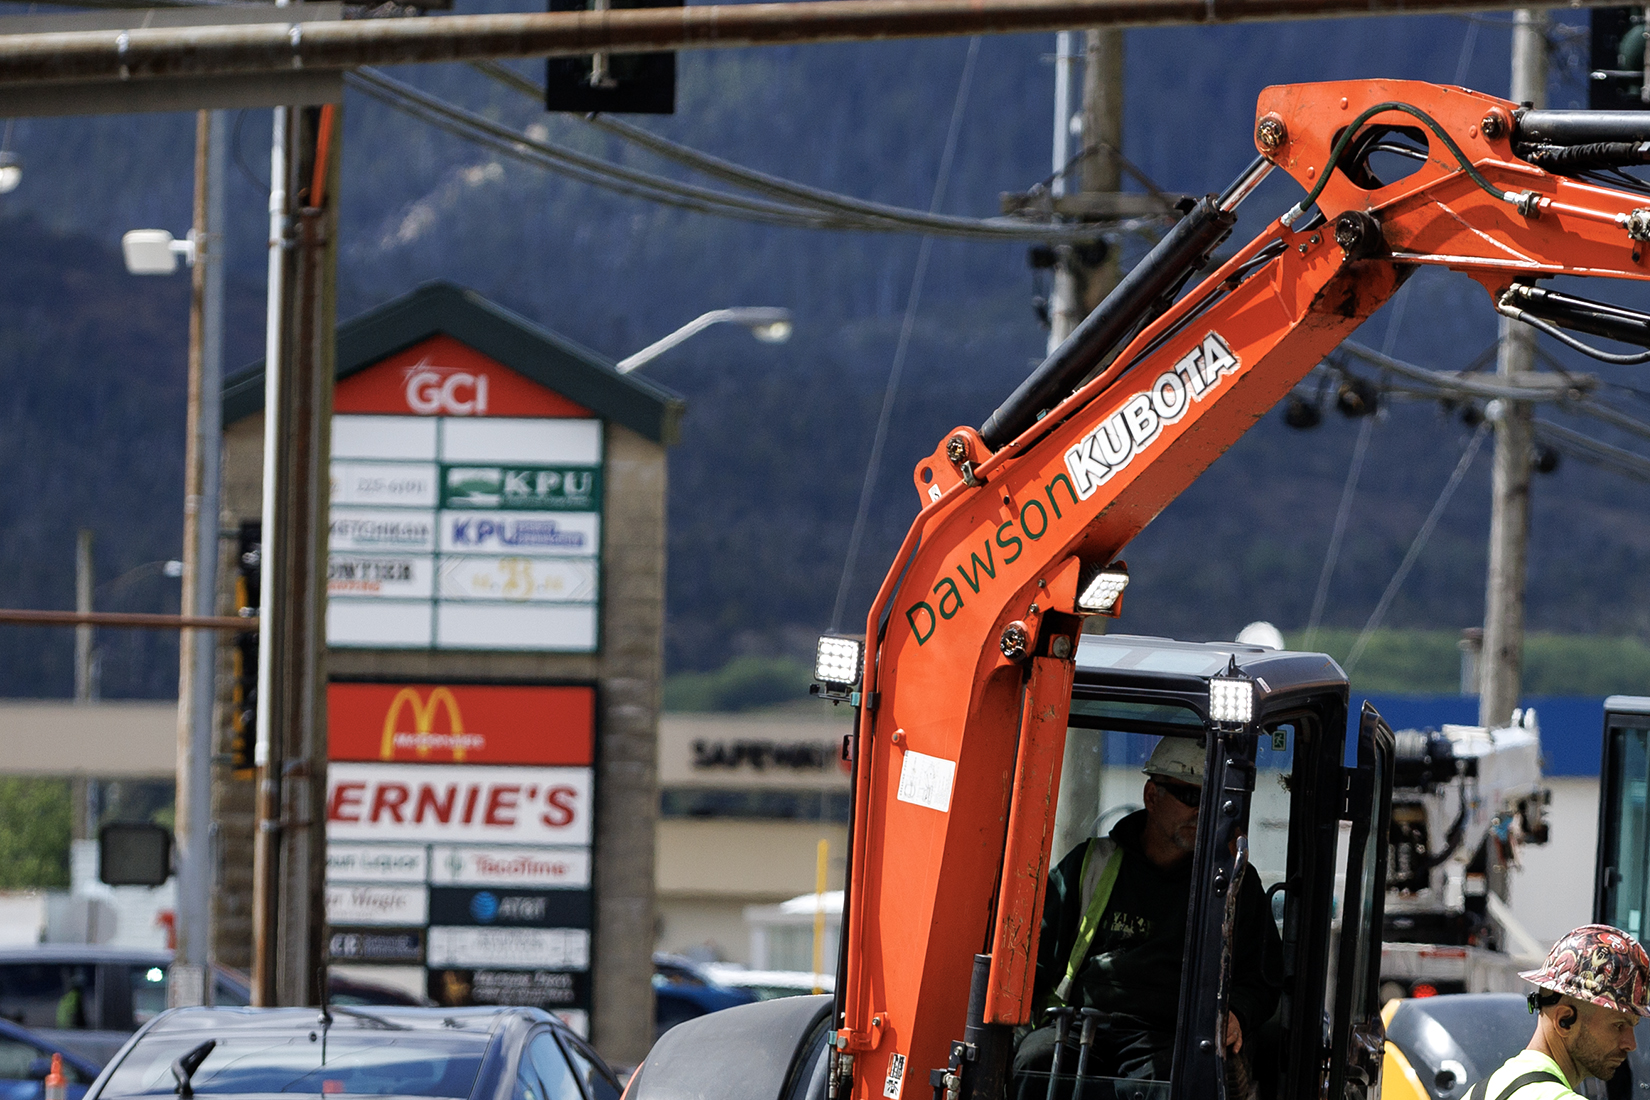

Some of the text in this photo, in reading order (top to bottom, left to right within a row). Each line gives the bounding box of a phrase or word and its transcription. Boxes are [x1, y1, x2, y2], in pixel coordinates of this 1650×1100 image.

[405, 371, 489, 416] GCI
[1068, 332, 1239, 494] KUBOTA
[503, 469, 594, 498] KPU
[452, 517, 519, 546] KPU
[905, 472, 1079, 647] Dawson
[328, 780, 578, 829] ERNIE'S
